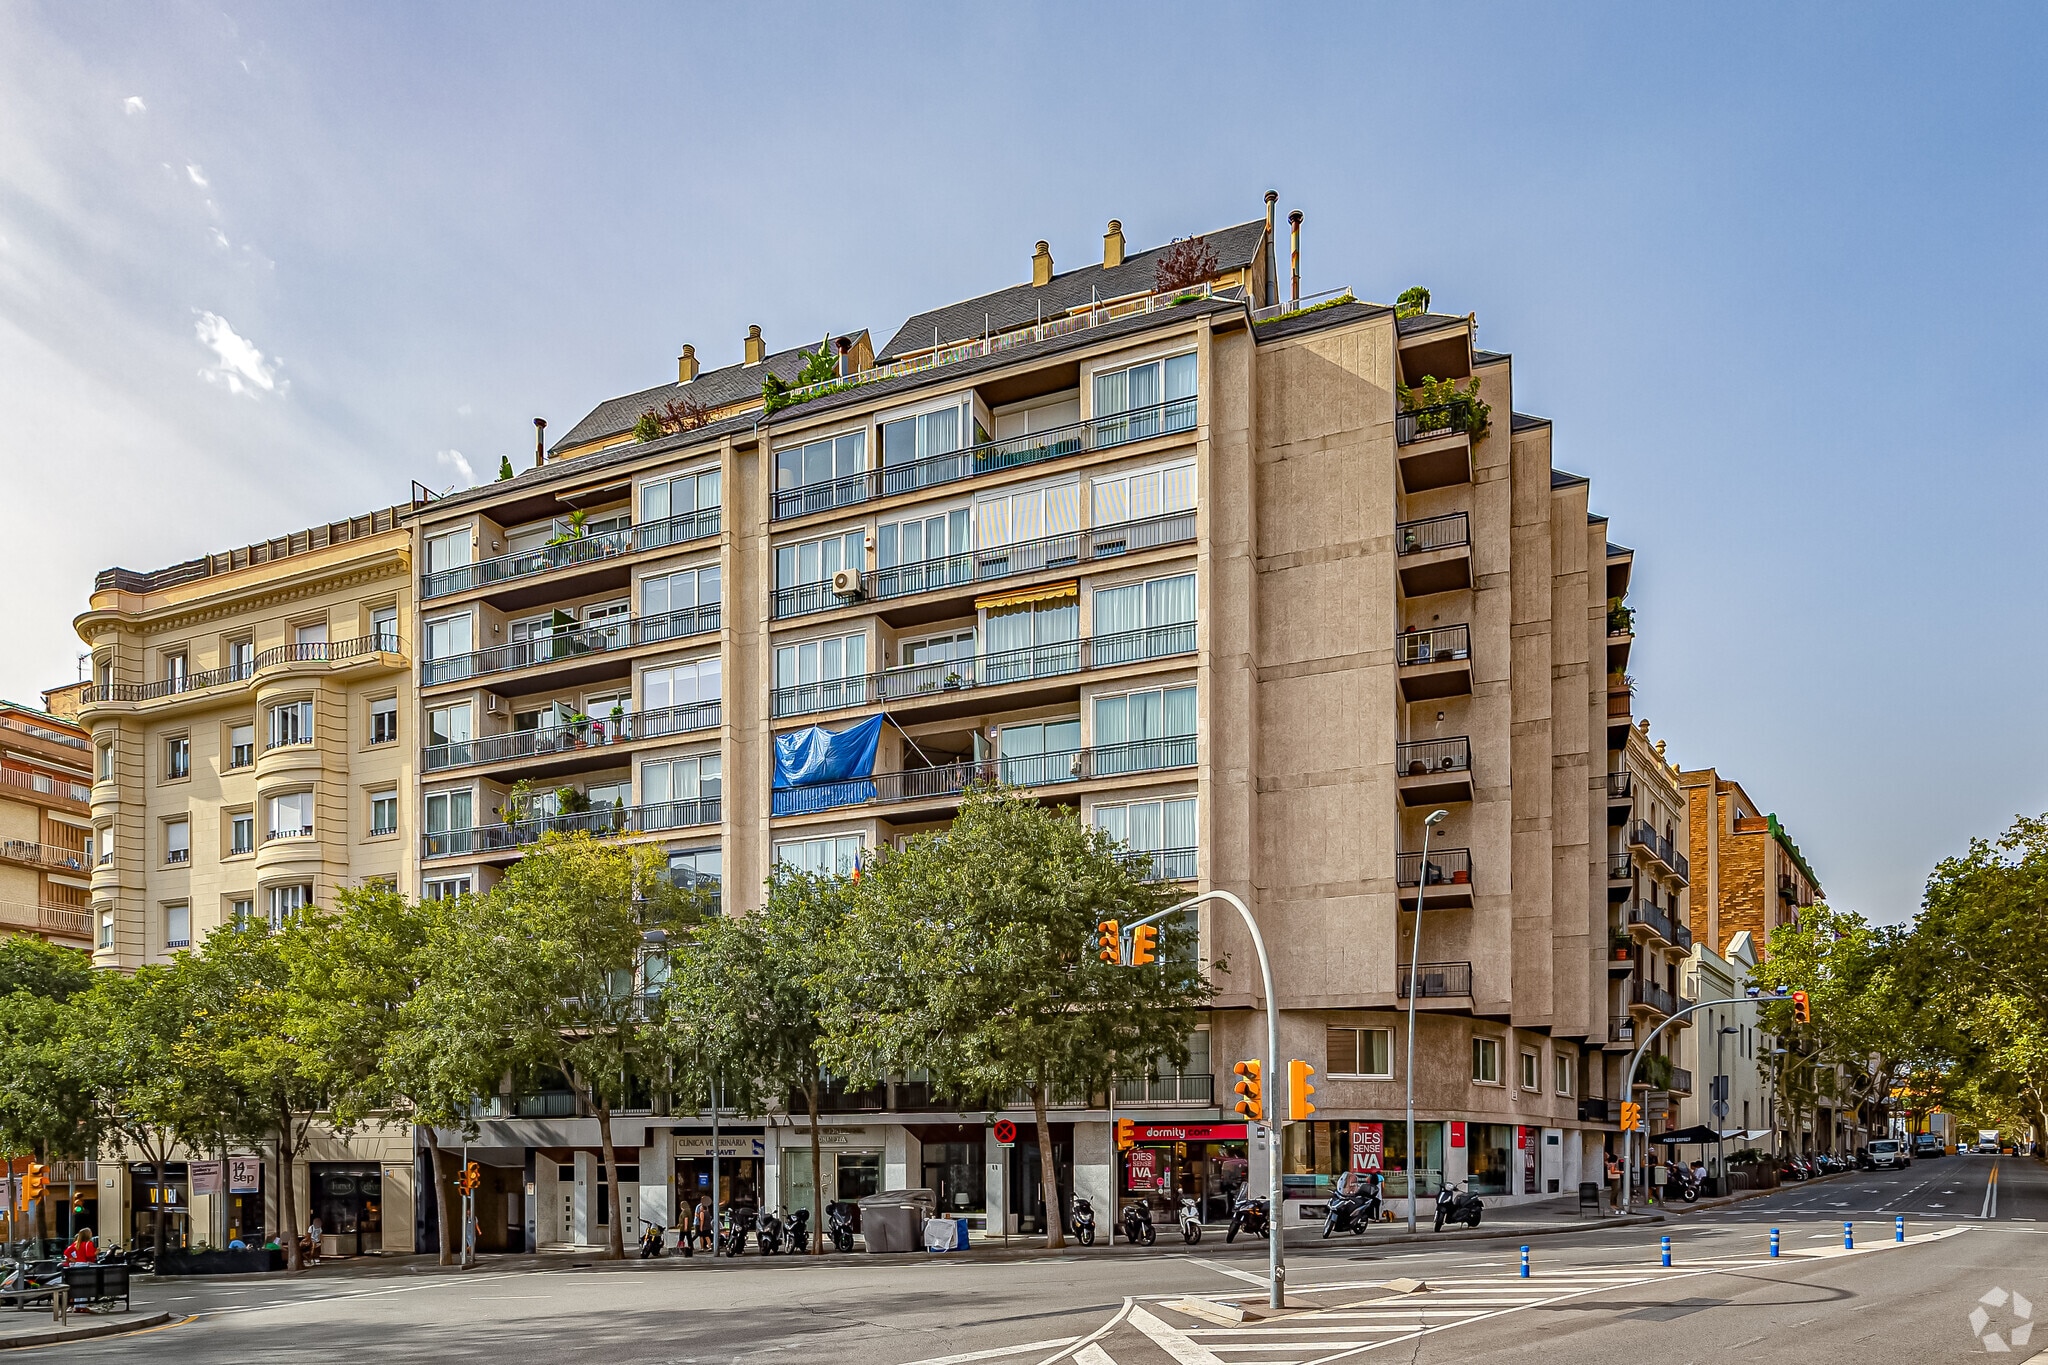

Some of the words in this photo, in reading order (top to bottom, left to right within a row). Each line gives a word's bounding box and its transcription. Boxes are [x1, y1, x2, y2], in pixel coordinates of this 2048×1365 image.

[1146, 1127, 1186, 1139] dormity
[1353, 1132, 1381, 1144] DIES
[679, 1137, 705, 1147] CLÍNICA
[705, 1137, 747, 1147] VEERINÀRIA
[1353, 1144, 1381, 1153] SENSE
[1132, 1152, 1152, 1161] DIES
[1353, 1153, 1381, 1169] IVA
[232, 1161, 245, 1171] 14
[1132, 1167, 1152, 1178] IVA
[233, 1174, 255, 1184] sep
